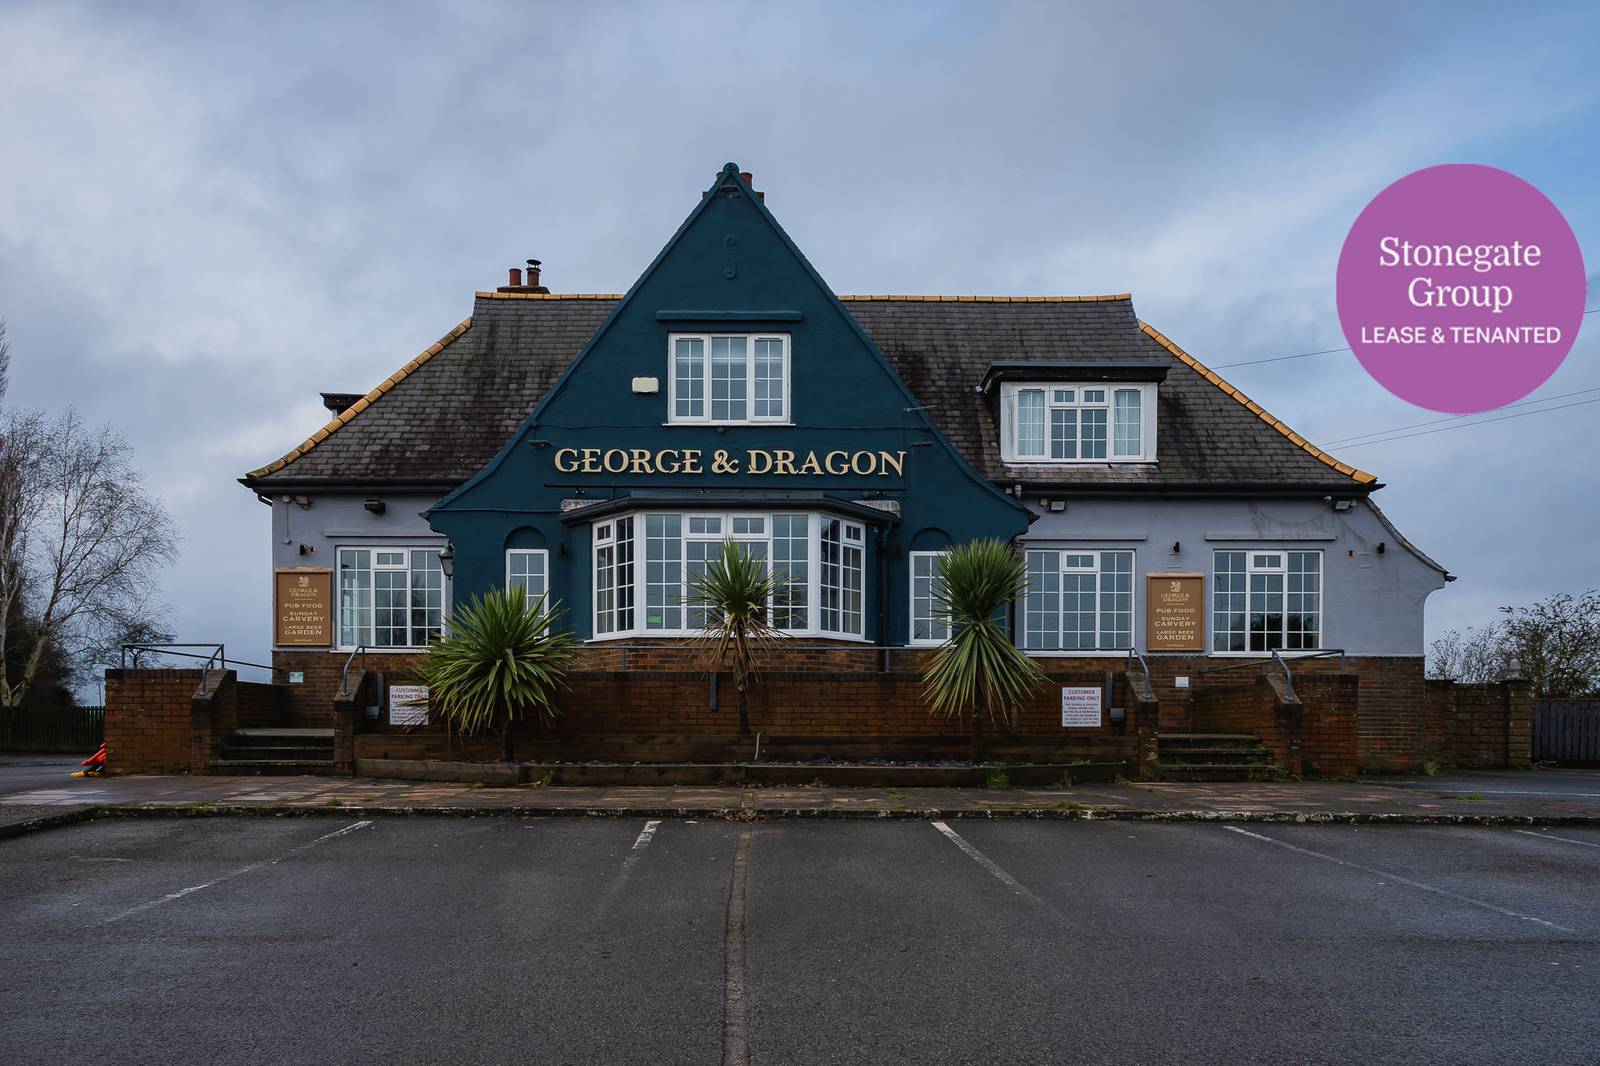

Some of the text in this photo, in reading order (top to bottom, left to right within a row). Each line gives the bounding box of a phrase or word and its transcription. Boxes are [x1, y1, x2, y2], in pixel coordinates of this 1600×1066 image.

[554, 448, 906, 477] GEORGE & DRAGON
